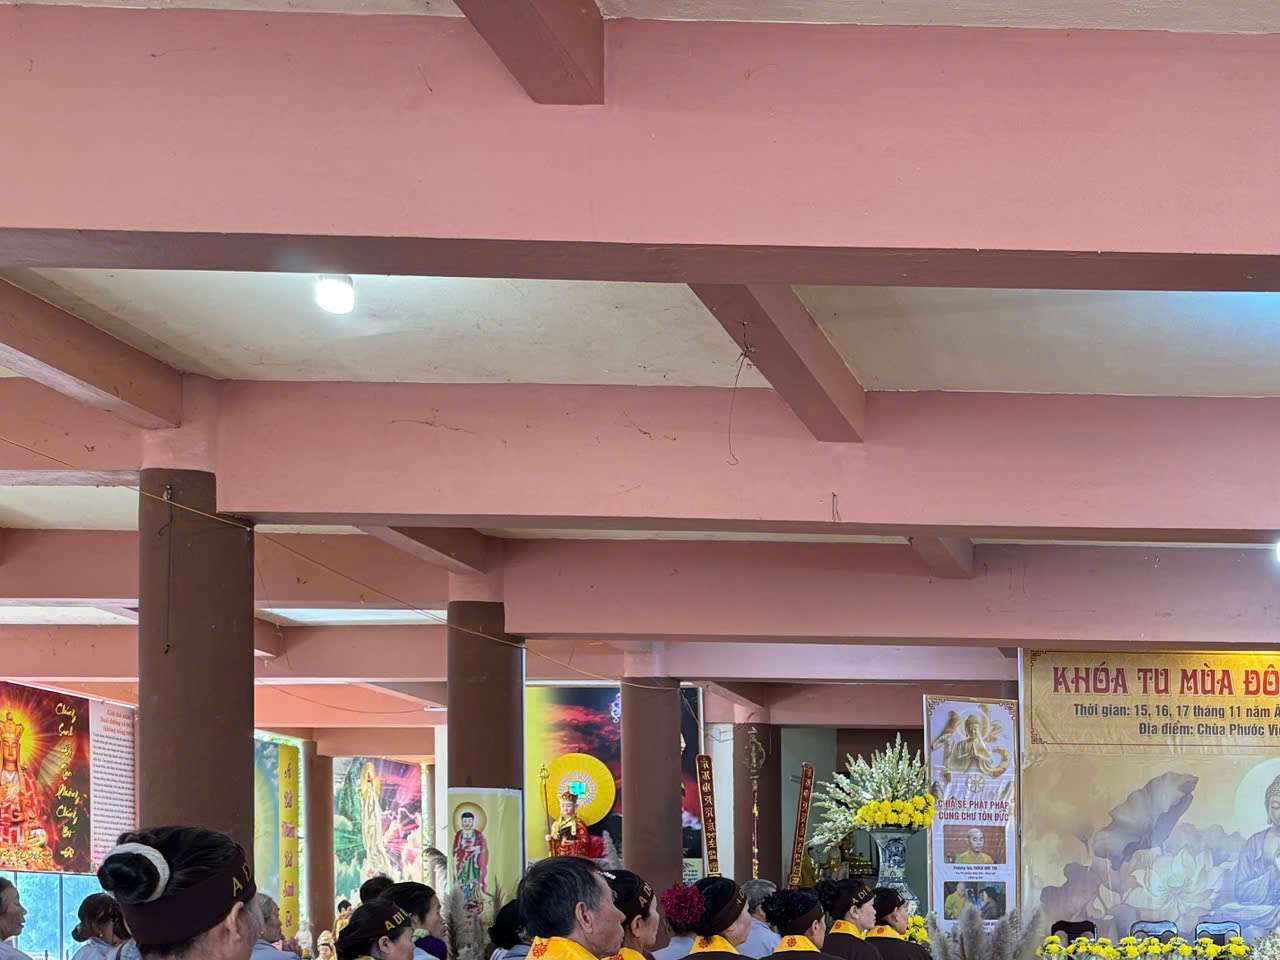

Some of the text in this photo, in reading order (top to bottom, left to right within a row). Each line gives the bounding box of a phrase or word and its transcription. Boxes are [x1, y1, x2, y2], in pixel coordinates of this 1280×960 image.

[1052, 661, 1129, 694] KHÓA
[1137, 668, 1170, 695] TU
[1179, 663, 1234, 696] MÙA
[1074, 703, 1098, 717] Thời
[1102, 705, 1130, 718] gian:
[1134, 704, 1151, 718] 15,
[1155, 705, 1172, 718] 16,
[1176, 705, 1189, 717] 17
[1193, 705, 1225, 719] tháng
[1229, 706, 1241, 718] 11
[1246, 706, 1270, 718] năm
[1139, 722, 1157, 738] Địa
[1161, 720, 1193, 736] điểm:
[1197, 723, 1225, 736] Chùa
[1229, 723, 1265, 737] Phước
